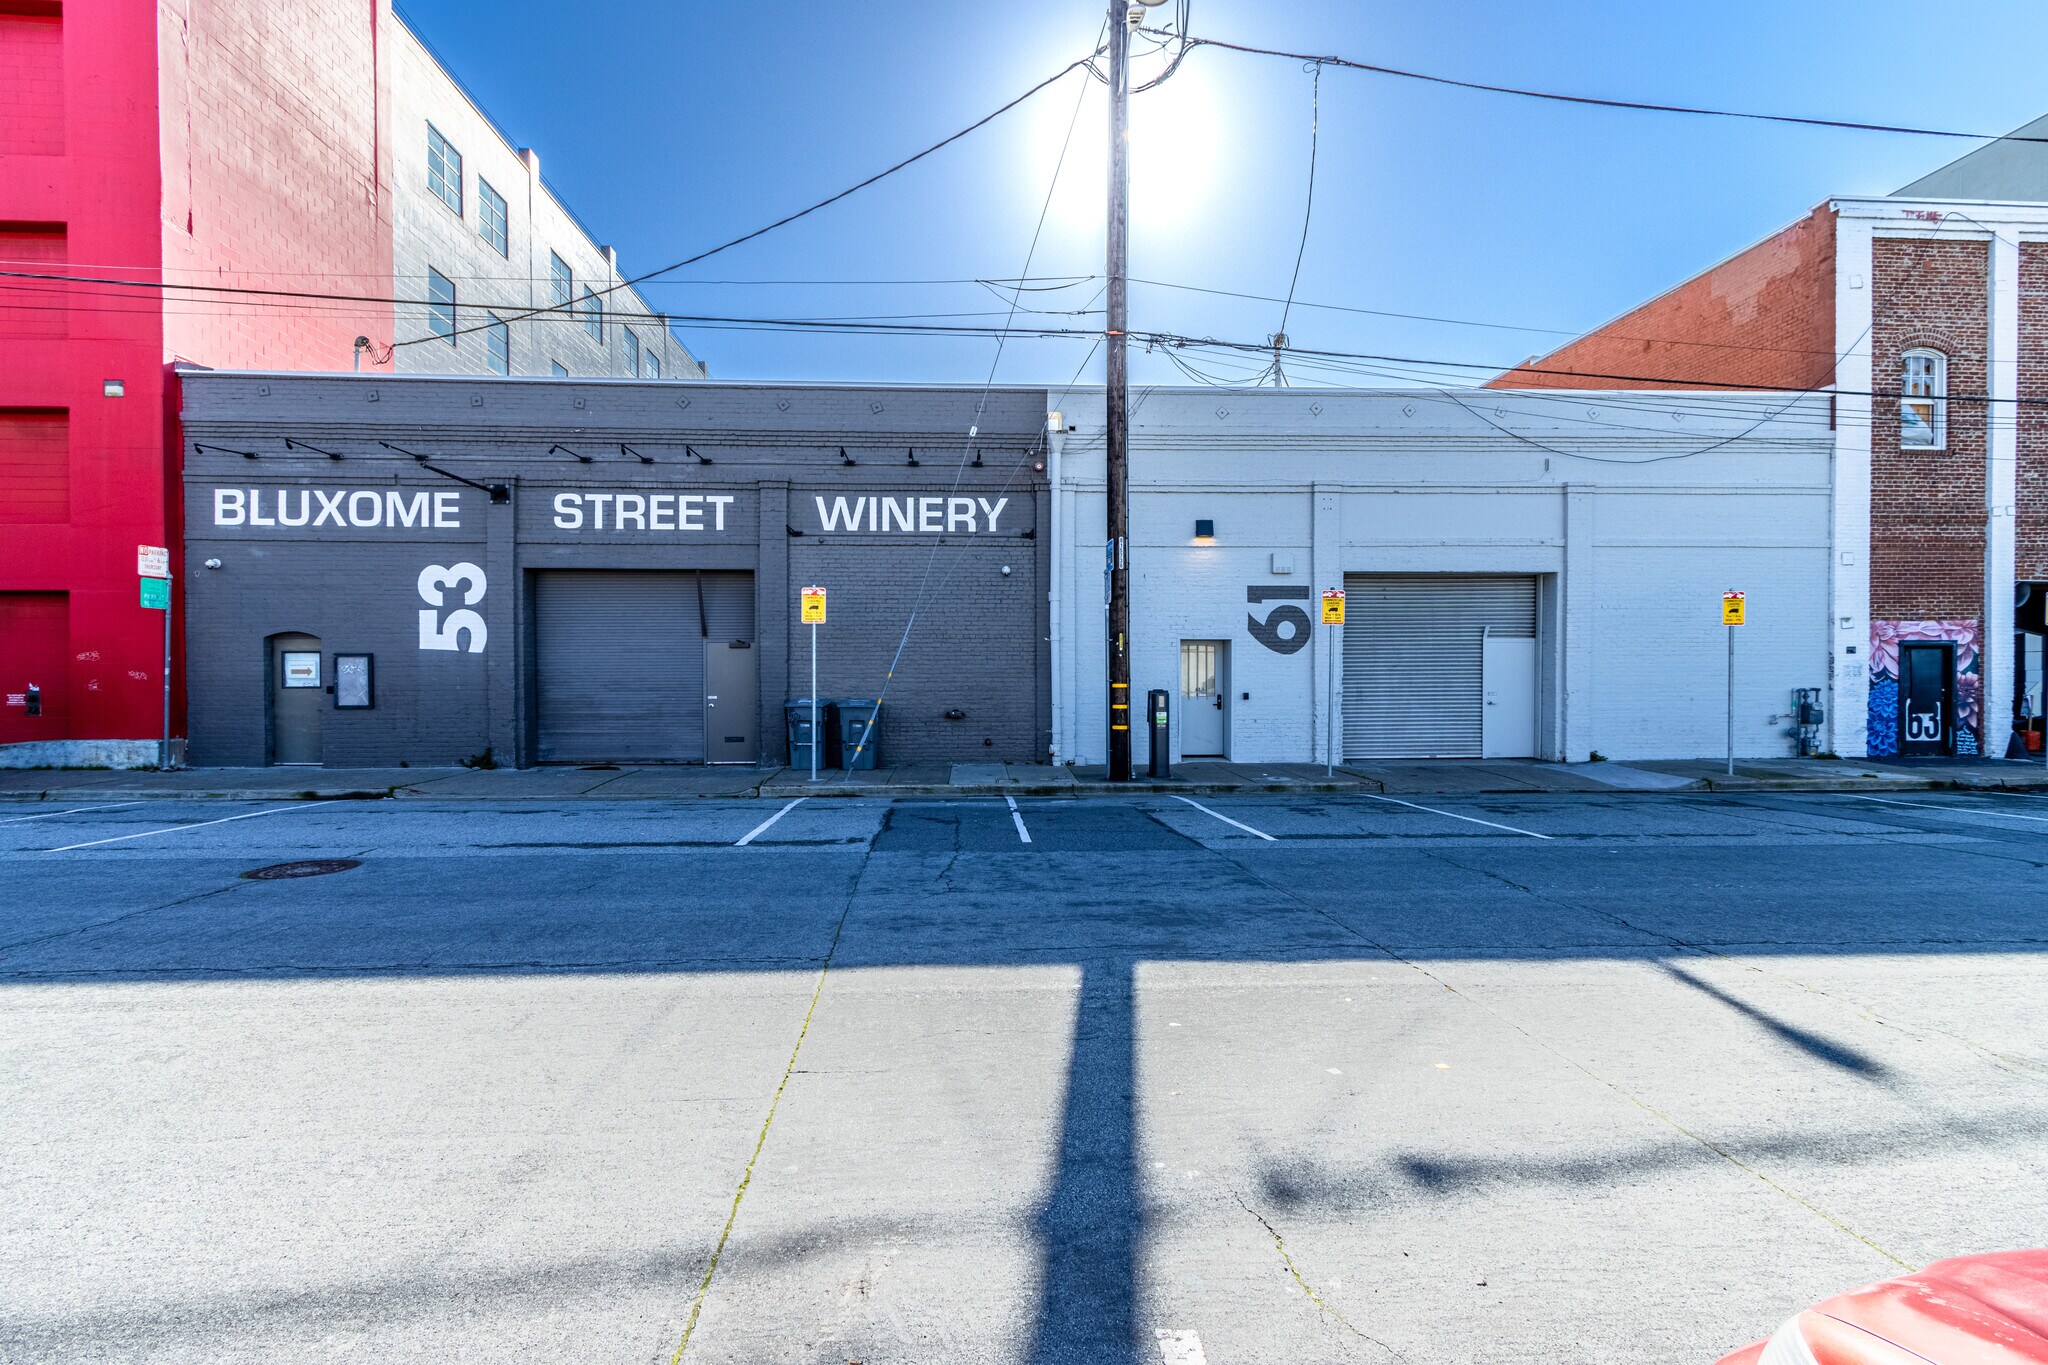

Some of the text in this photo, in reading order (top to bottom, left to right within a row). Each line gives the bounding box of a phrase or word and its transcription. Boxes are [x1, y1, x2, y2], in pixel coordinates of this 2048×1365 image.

[215, 488, 1008, 534] BLUXOME STREET WINERY
[417, 562, 488, 654] 53
[1246, 585, 1312, 655] 61
[1907, 699, 1940, 740] 63
